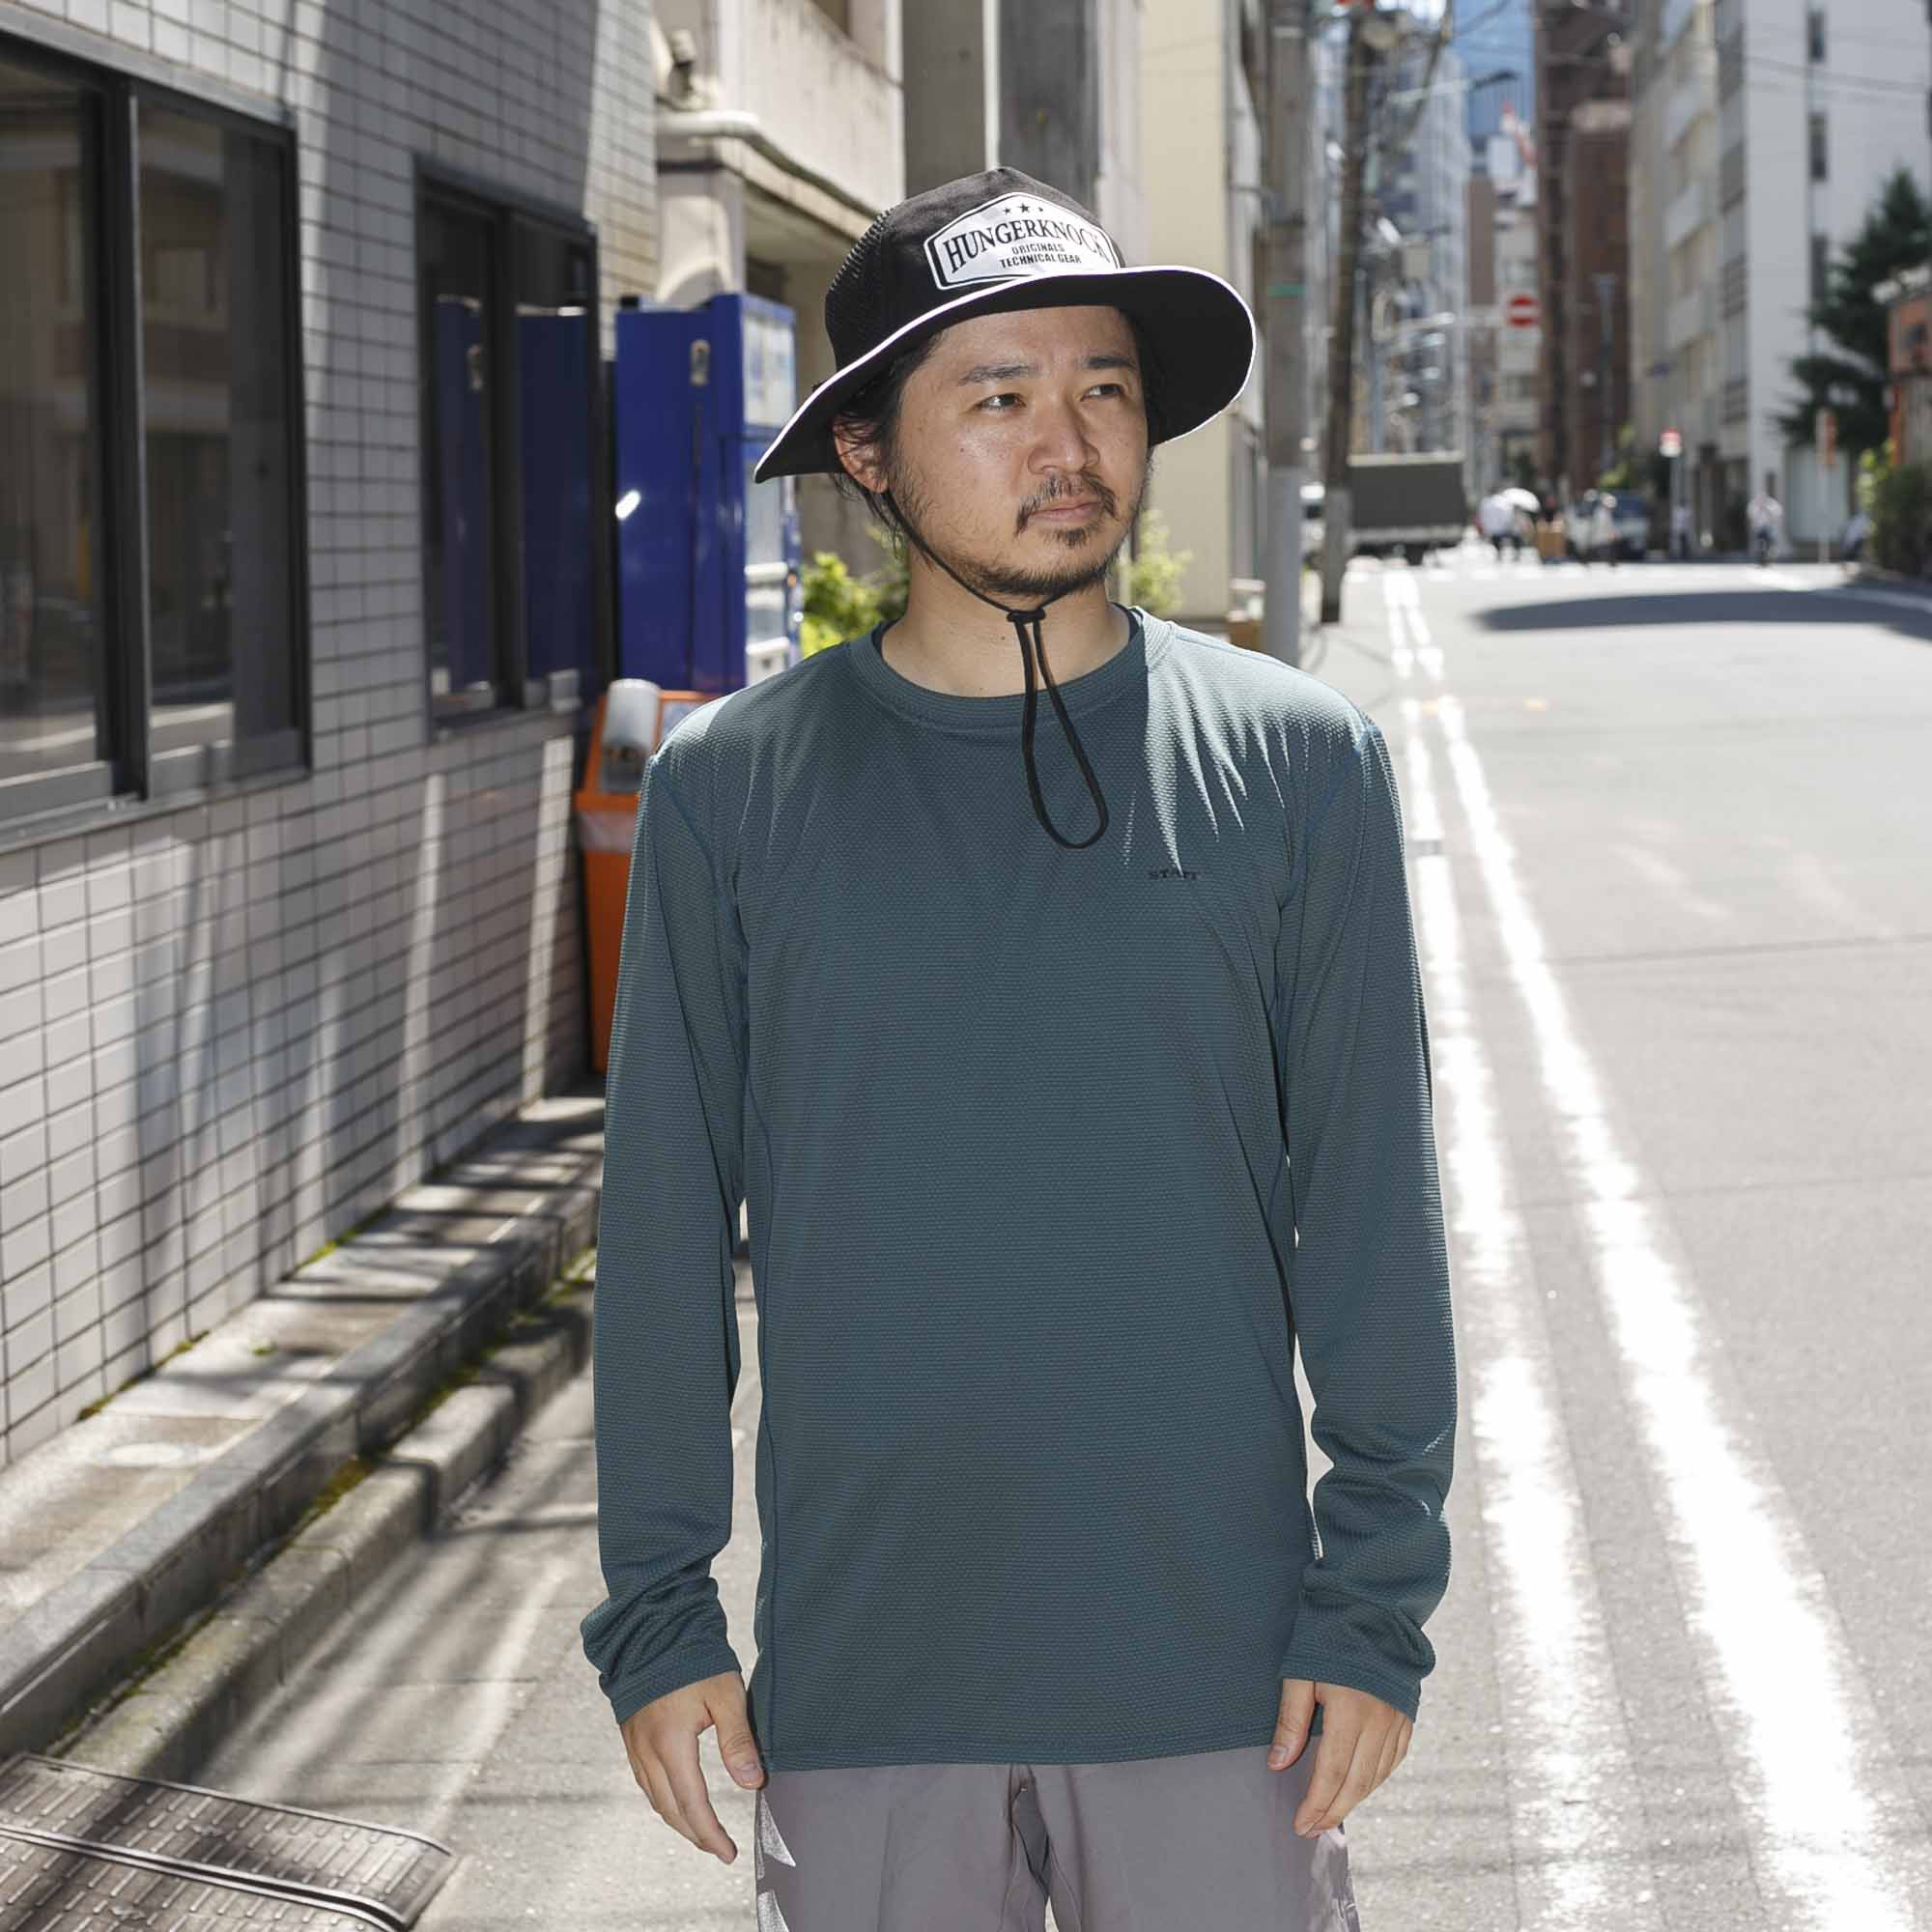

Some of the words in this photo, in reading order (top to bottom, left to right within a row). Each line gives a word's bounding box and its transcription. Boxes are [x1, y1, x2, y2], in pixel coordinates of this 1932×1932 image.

[943, 218, 1111, 274] HUNGERKNOCK
[1011, 242, 1065, 255] ORIGINALS
[999, 255, 1056, 269] TECHNICAL
[1058, 254, 1082, 264] GEAR
